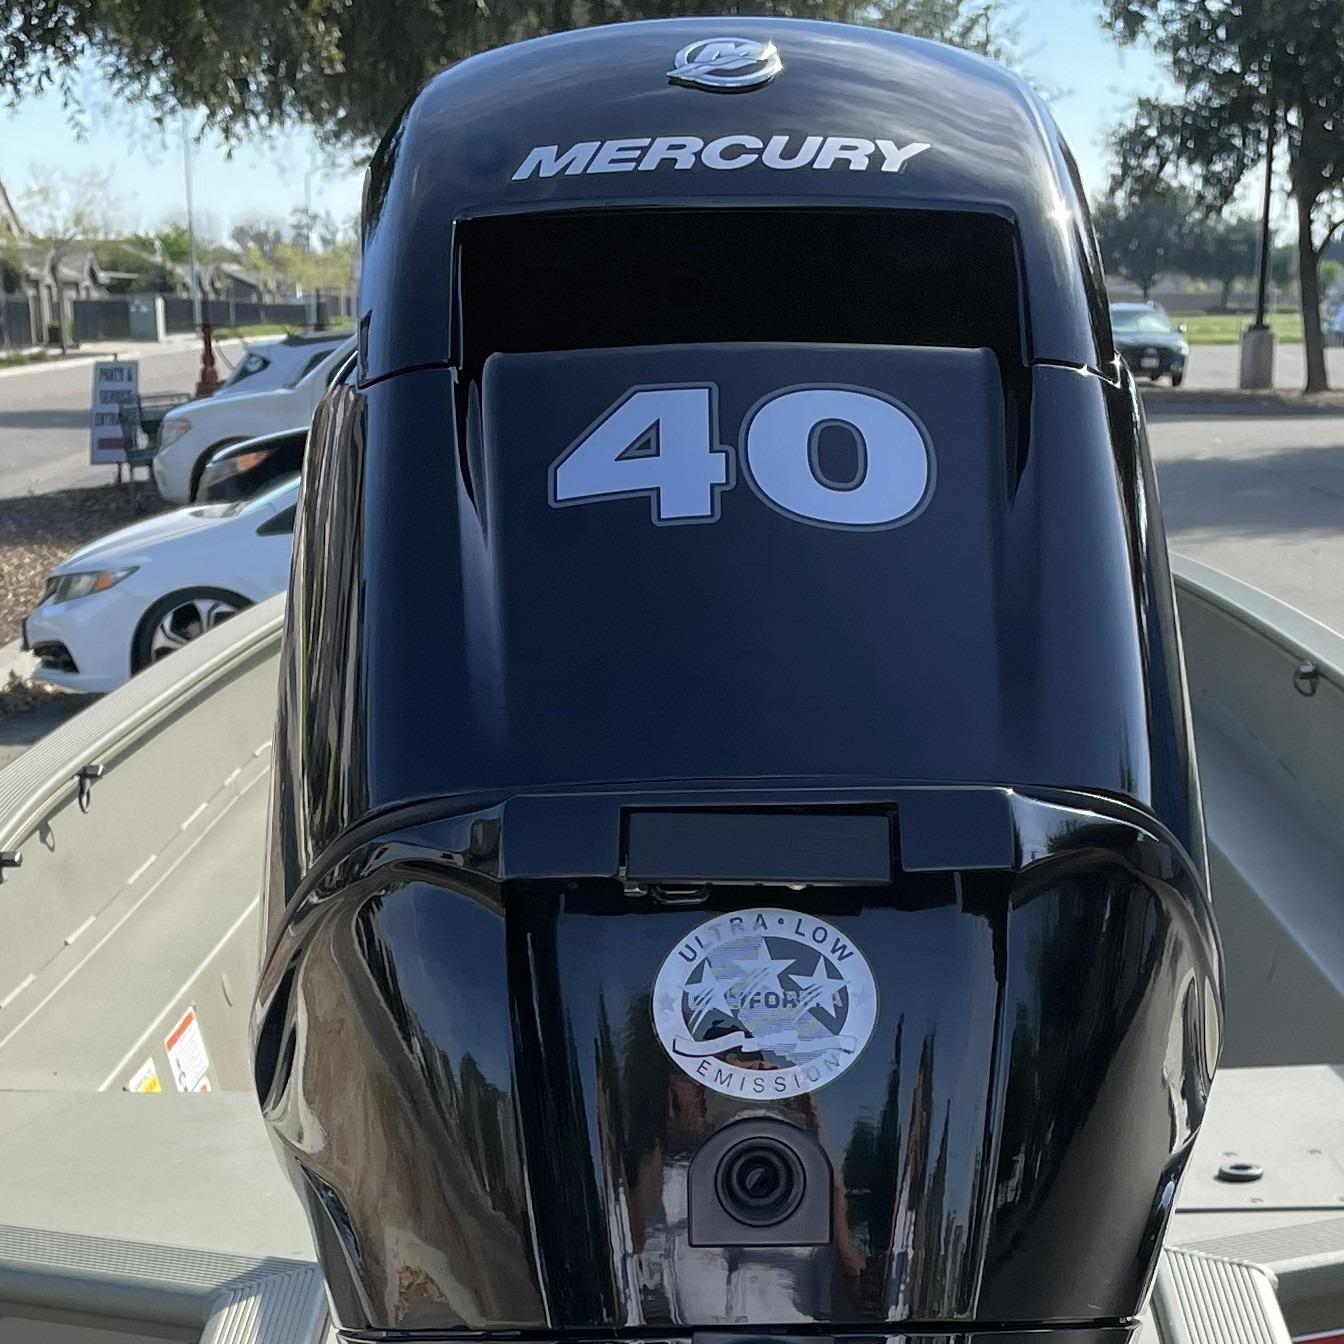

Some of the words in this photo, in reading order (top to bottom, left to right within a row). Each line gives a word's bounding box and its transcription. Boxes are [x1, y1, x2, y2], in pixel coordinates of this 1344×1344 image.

[511, 135, 932, 181] MERCURY
[549, 383, 937, 531] 40
[678, 913, 768, 963] ULTRA
[795, 917, 855, 962] LOW
[696, 1052, 840, 1093] EMISSION
